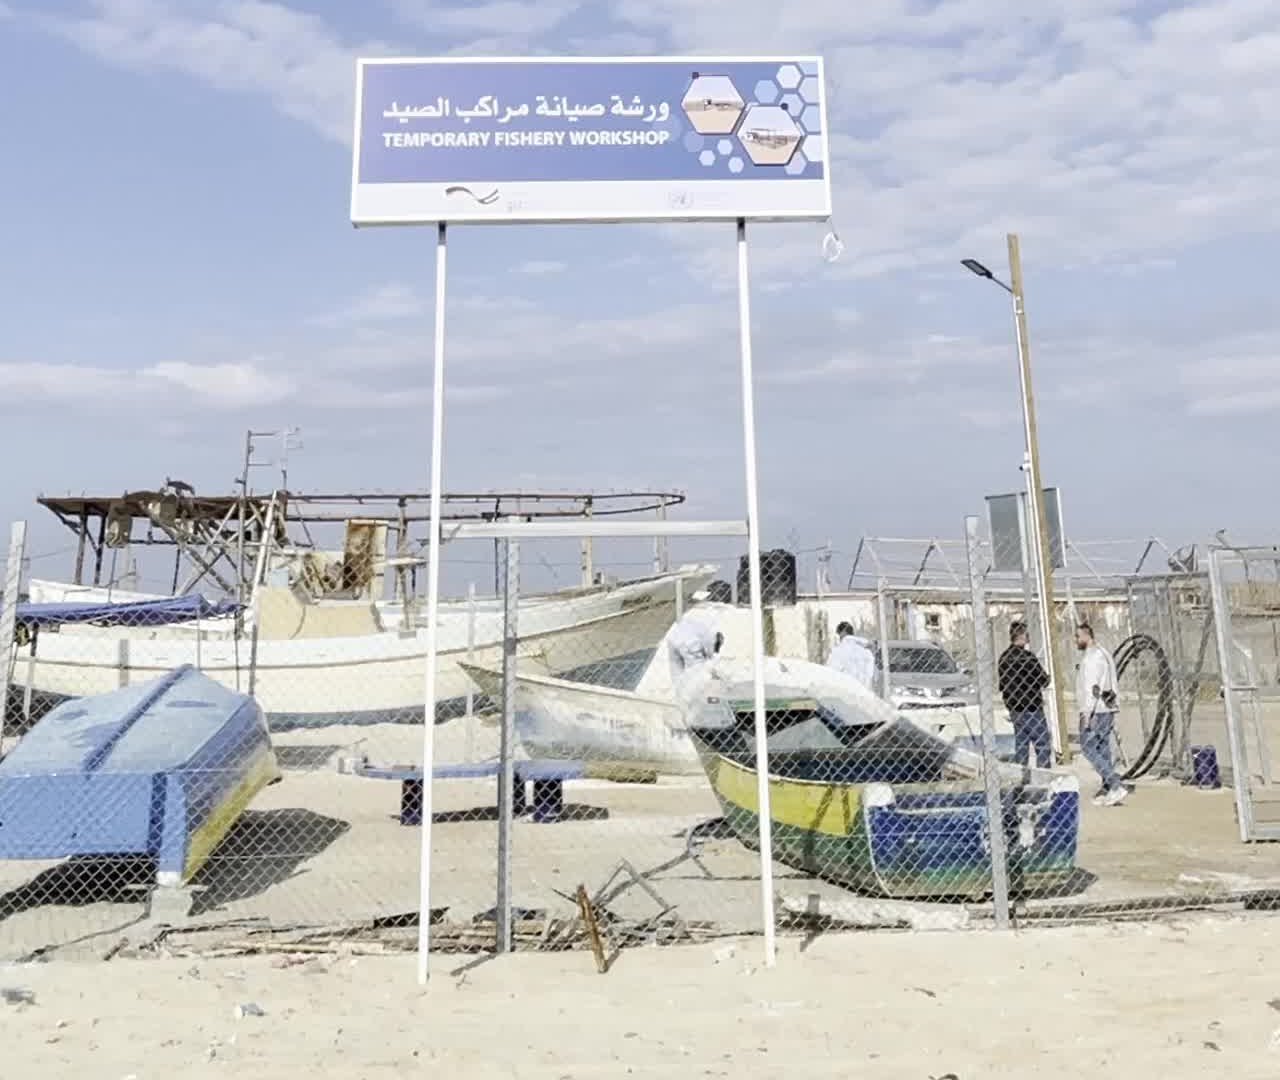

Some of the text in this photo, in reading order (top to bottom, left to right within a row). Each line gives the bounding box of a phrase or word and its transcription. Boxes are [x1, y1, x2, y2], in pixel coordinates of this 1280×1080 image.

[383, 94, 670, 123] ورشة صيانة مراكب الصيد
[382, 129, 670, 147] TEMPORARY FISHERY WORKSHOP
